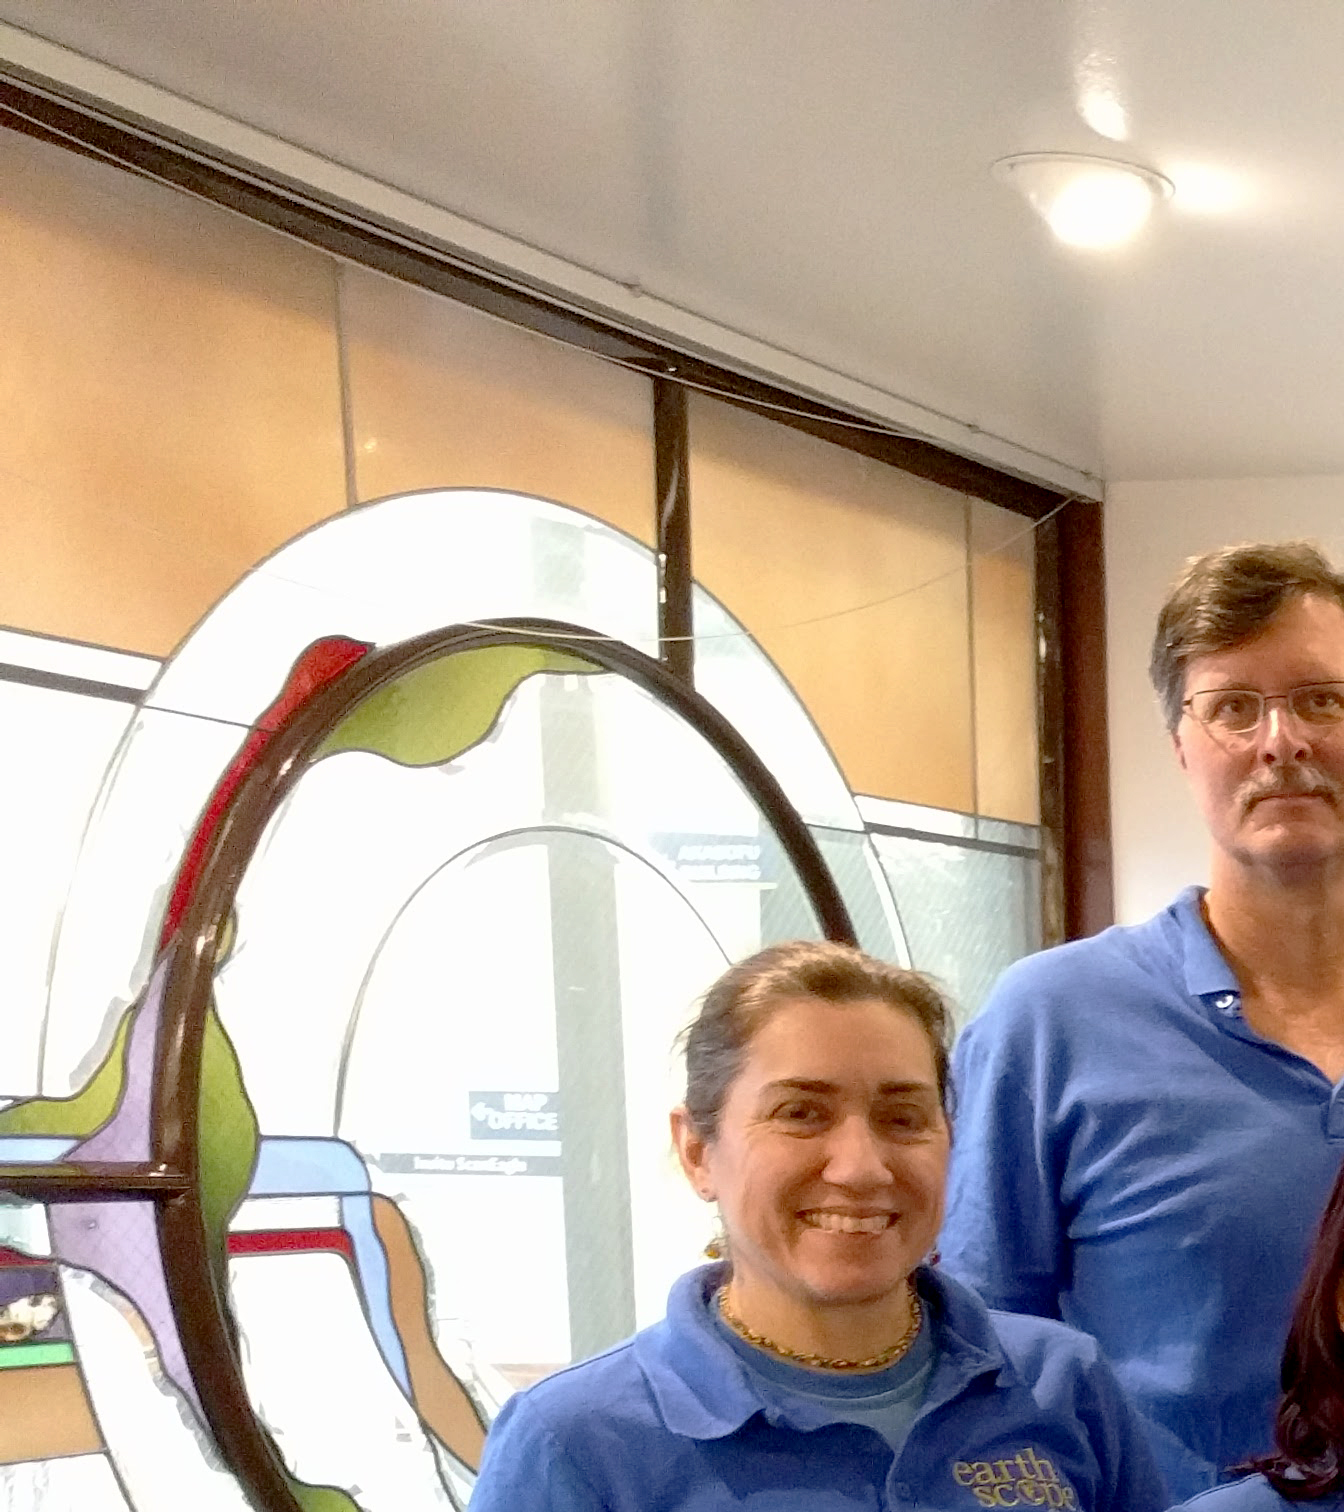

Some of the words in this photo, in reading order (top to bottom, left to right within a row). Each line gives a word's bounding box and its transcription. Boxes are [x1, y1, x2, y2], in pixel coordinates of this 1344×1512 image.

[503, 1093, 548, 1112] MAP
[488, 1111, 559, 1131] OFFICE
[953, 1447, 1060, 1487] earth
